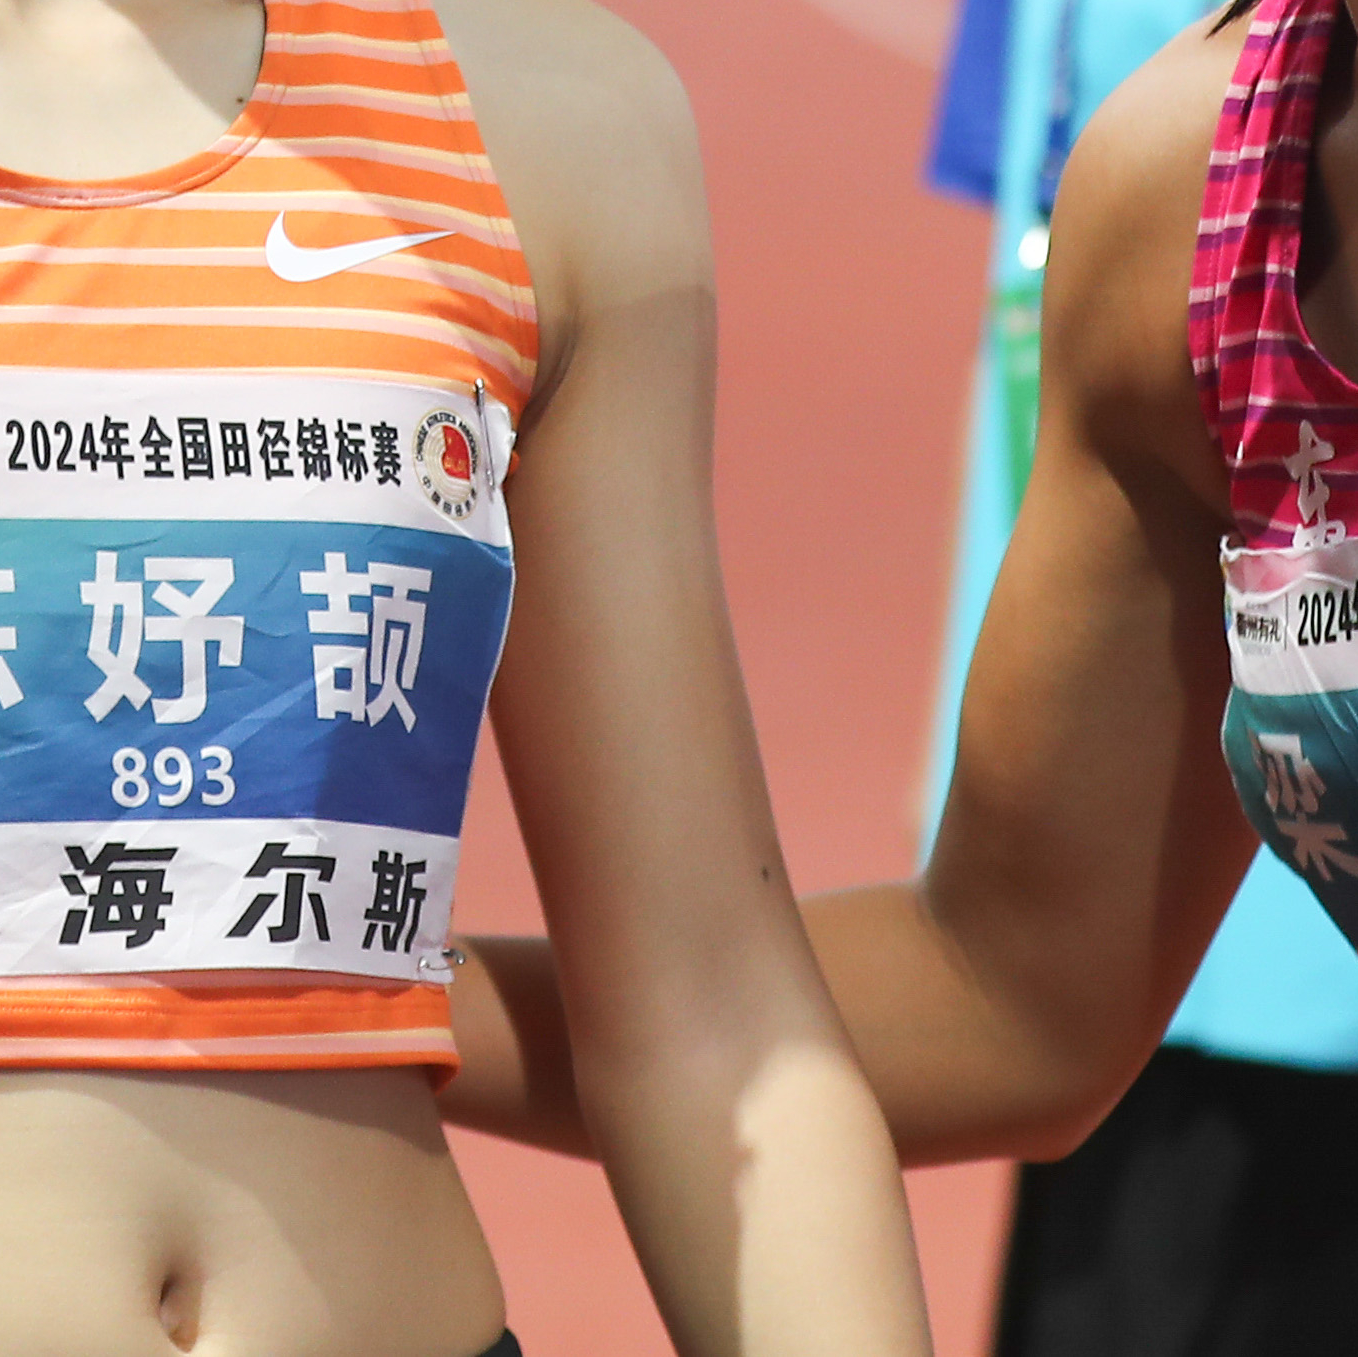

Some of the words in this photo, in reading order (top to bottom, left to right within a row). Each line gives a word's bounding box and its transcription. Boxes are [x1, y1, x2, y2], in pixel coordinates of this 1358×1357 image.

[5, 414, 403, 487] 2024年全国田径锦标赛
[110, 745, 236, 808] 893
[59, 842, 428, 953] 海尔斯
